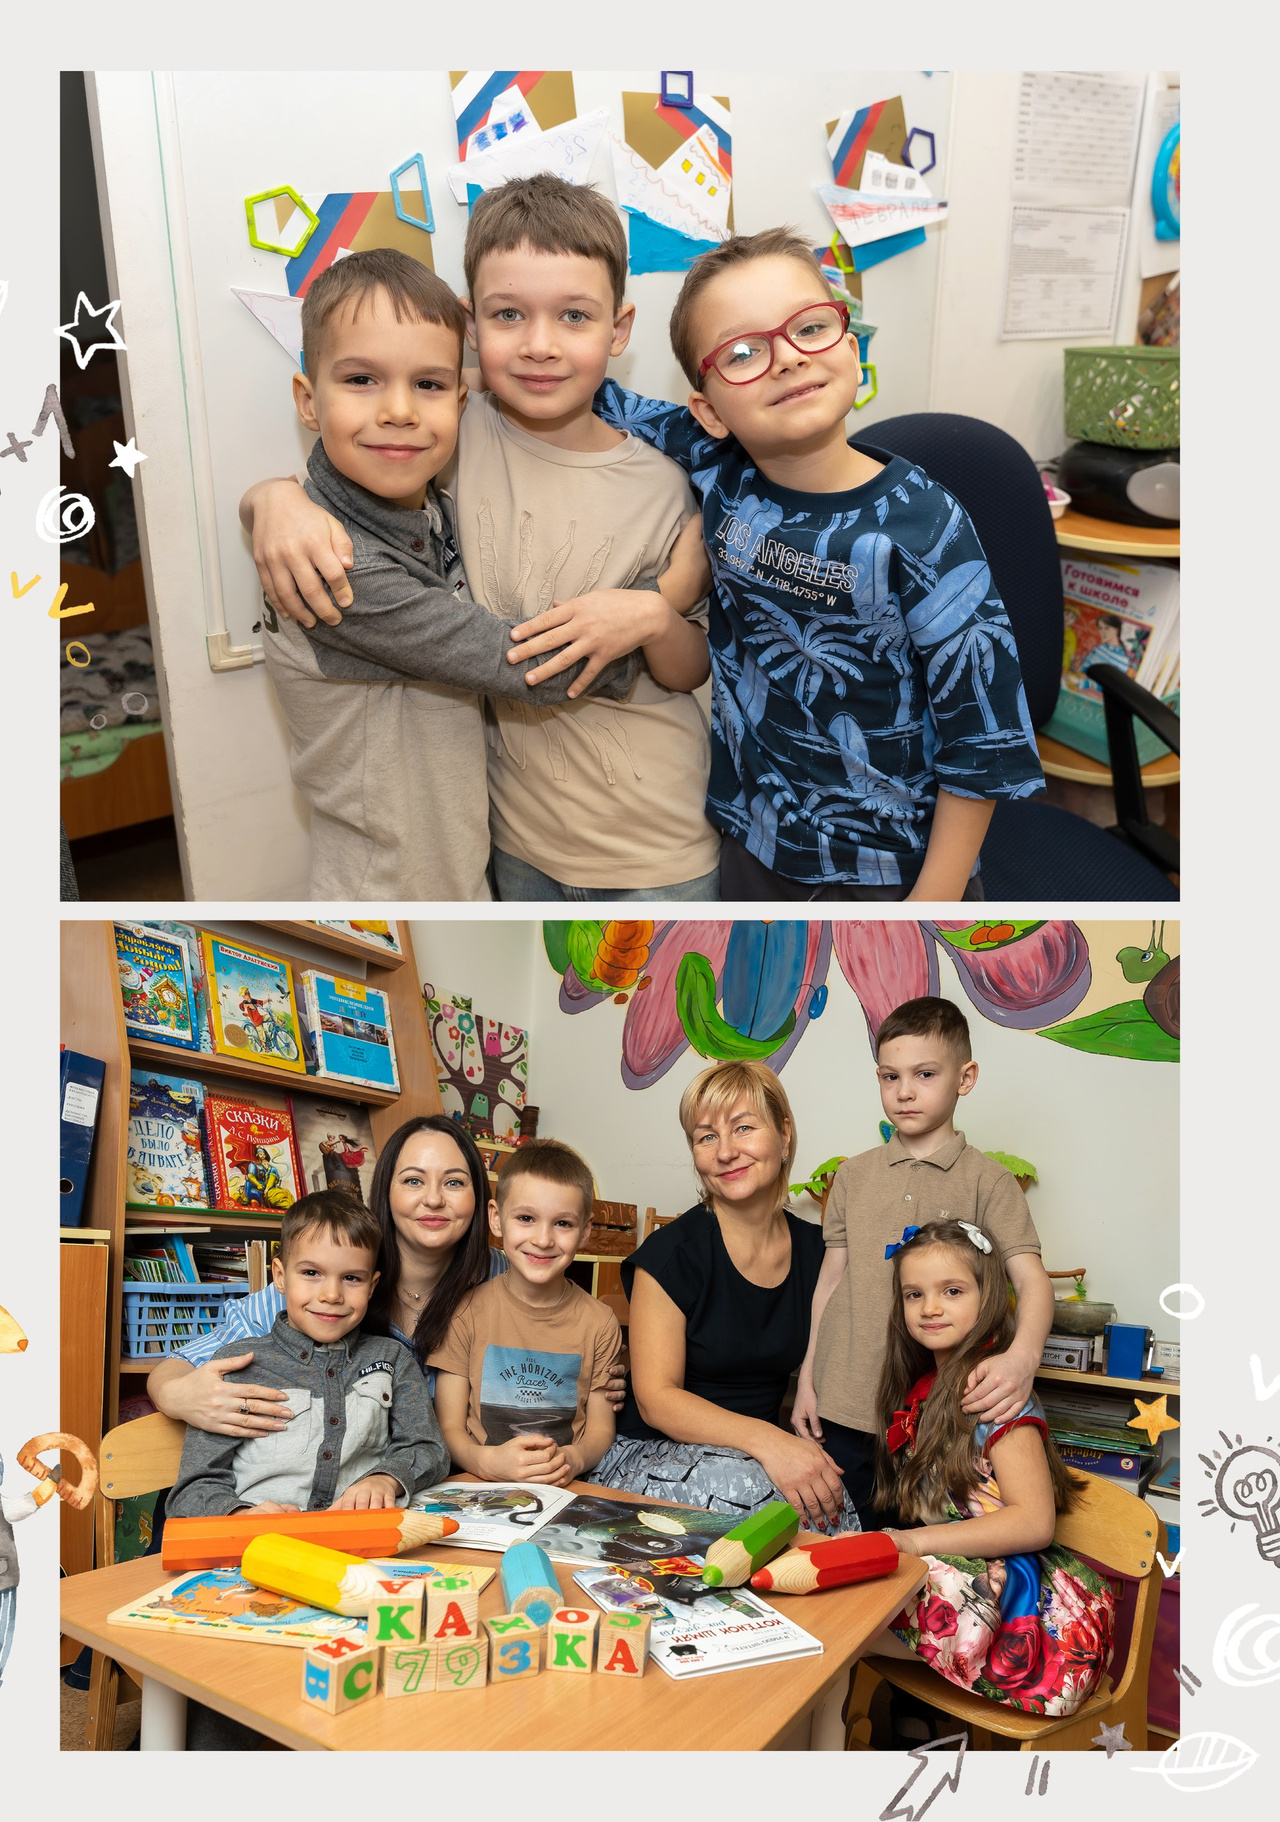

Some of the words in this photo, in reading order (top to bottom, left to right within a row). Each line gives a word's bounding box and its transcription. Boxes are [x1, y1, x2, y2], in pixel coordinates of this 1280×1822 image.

[714, 511, 752, 551] LOS
[749, 534, 858, 594] ANGELES
[1065, 563, 1140, 598] Готовимся
[827, 594, 837, 607] W
[1080, 585, 1129, 608] школе
[339, 1005, 367, 1018] ДЕТЕЙ
[225, 1110, 279, 1131] СКАЗКИ
[133, 1120, 175, 1140] ДЕЛО
[140, 1138, 170, 1151] БЫЛО
[246, 1134, 280, 1145] Пушкина
[127, 1146, 136, 1159] В
[138, 1151, 187, 1168] ЯНВАРЕ
[212, 1162, 221, 1200] СКАЗКИ
[499, 1365, 518, 1382] THE
[520, 1363, 565, 1388] HORIZON
[515, 1375, 549, 1391] Racer
[432, 1577, 469, 1590] Ф
[194, 1608, 234, 1618] Евразия
[719, 1618, 785, 1635] КОТЁНОК
[670, 1629, 717, 1644] ШМЯК
